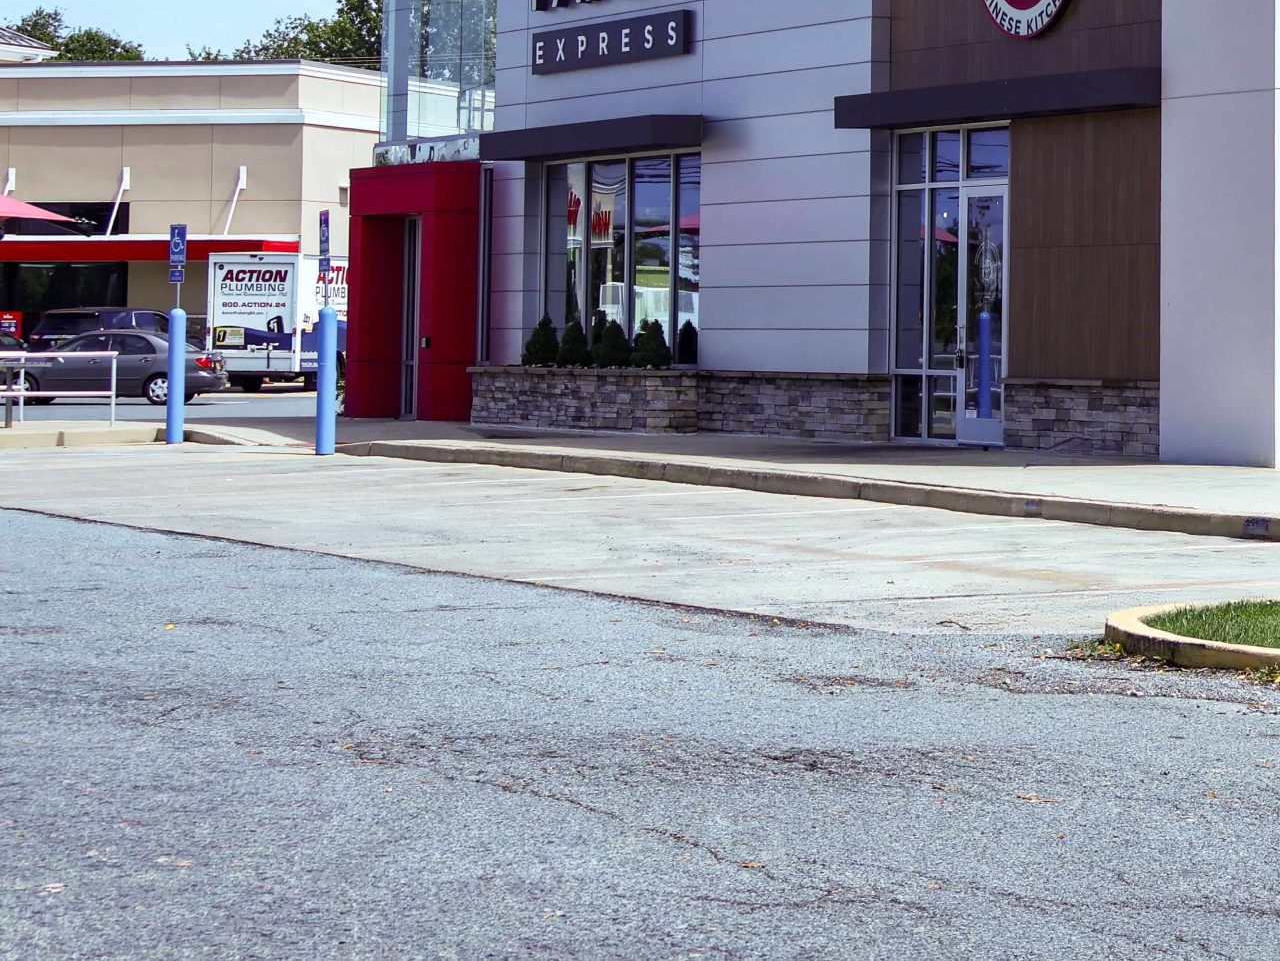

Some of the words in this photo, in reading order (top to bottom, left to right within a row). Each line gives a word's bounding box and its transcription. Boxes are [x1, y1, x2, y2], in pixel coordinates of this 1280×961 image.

[535, 21, 677, 65] EXPRESS
[221, 269, 289, 283] ACTION
[220, 283, 286, 292] PLUMBING
